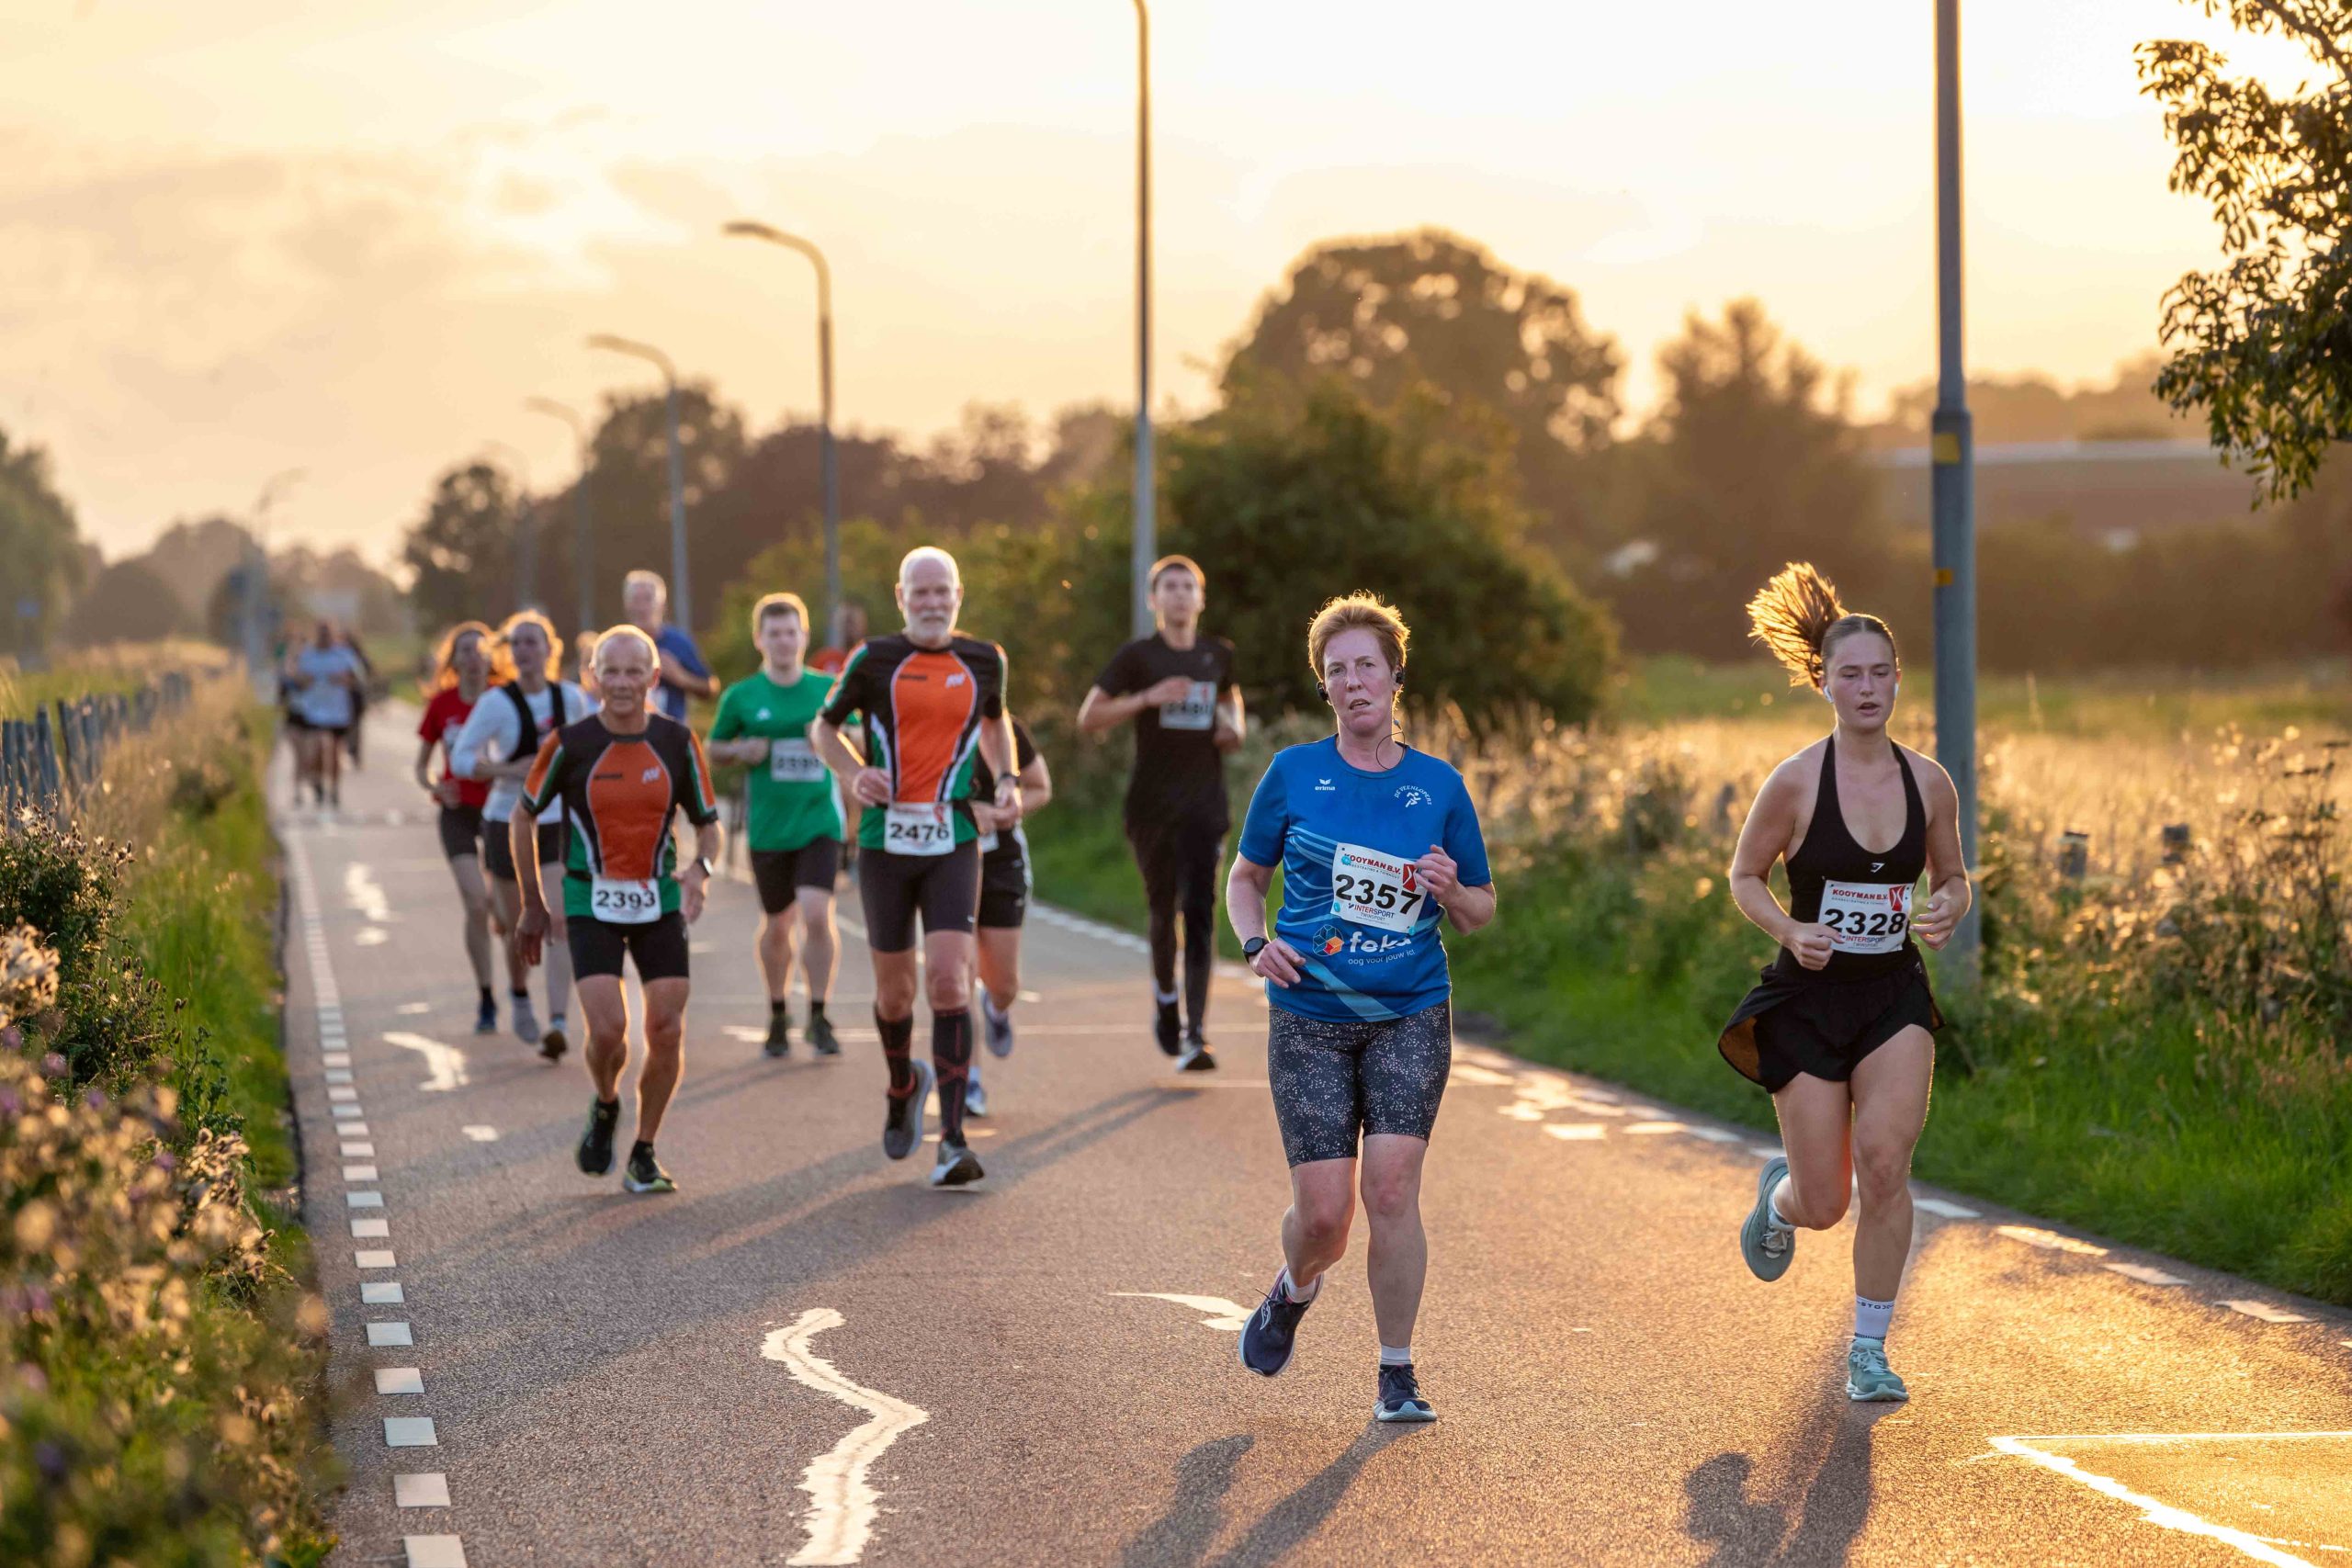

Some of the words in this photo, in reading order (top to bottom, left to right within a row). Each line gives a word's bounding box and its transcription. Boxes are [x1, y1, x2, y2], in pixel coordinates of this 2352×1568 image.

[889, 821, 949, 840] 2476
[1344, 853, 1386, 870] OOYMAN
[595, 889, 656, 909] 2393
[1335, 874, 1422, 915] 2357
[1832, 888, 1875, 899] KOOYMAN
[1354, 904, 1395, 919] INTERSPORT
[1825, 908, 1905, 936] 2328
[1385, 953, 1405, 963] jouw
